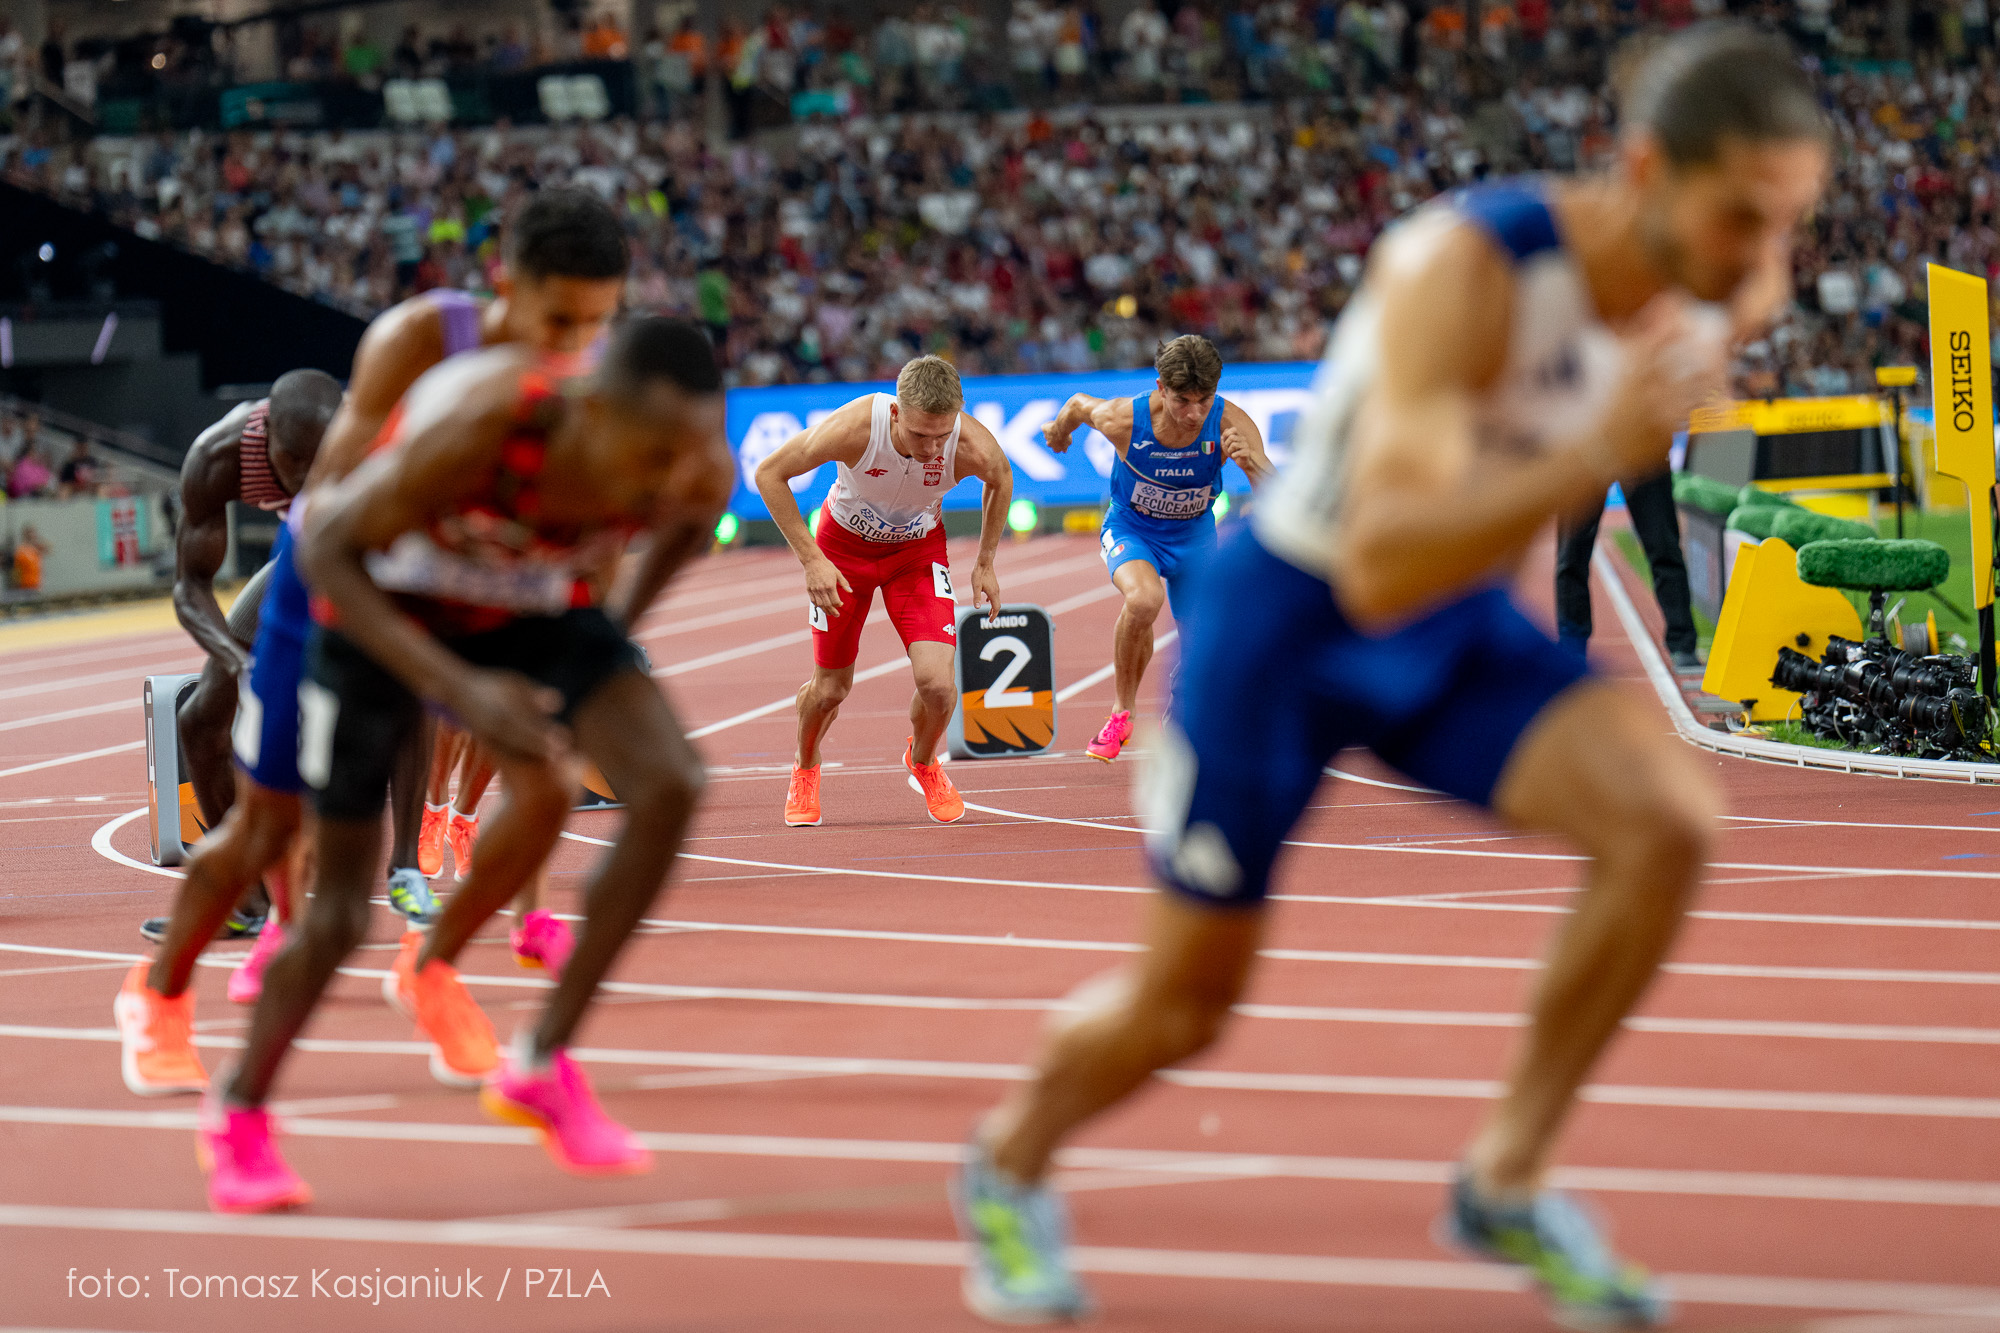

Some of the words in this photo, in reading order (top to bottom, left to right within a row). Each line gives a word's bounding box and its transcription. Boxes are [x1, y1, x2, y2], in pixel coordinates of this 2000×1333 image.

[1949, 330, 1974, 432] SEIKO
[864, 468, 888, 477] 4F
[1155, 469, 1194, 477] ITALIA
[1136, 493, 1204, 514] TECUCEANU
[1157, 488, 1206, 502] TDK
[849, 514, 924, 540] OSTROWSKI
[876, 514, 924, 534] TDK
[940, 570, 952, 594] 3
[980, 615, 1028, 630] MONDO
[979, 635, 1033, 709] 2
